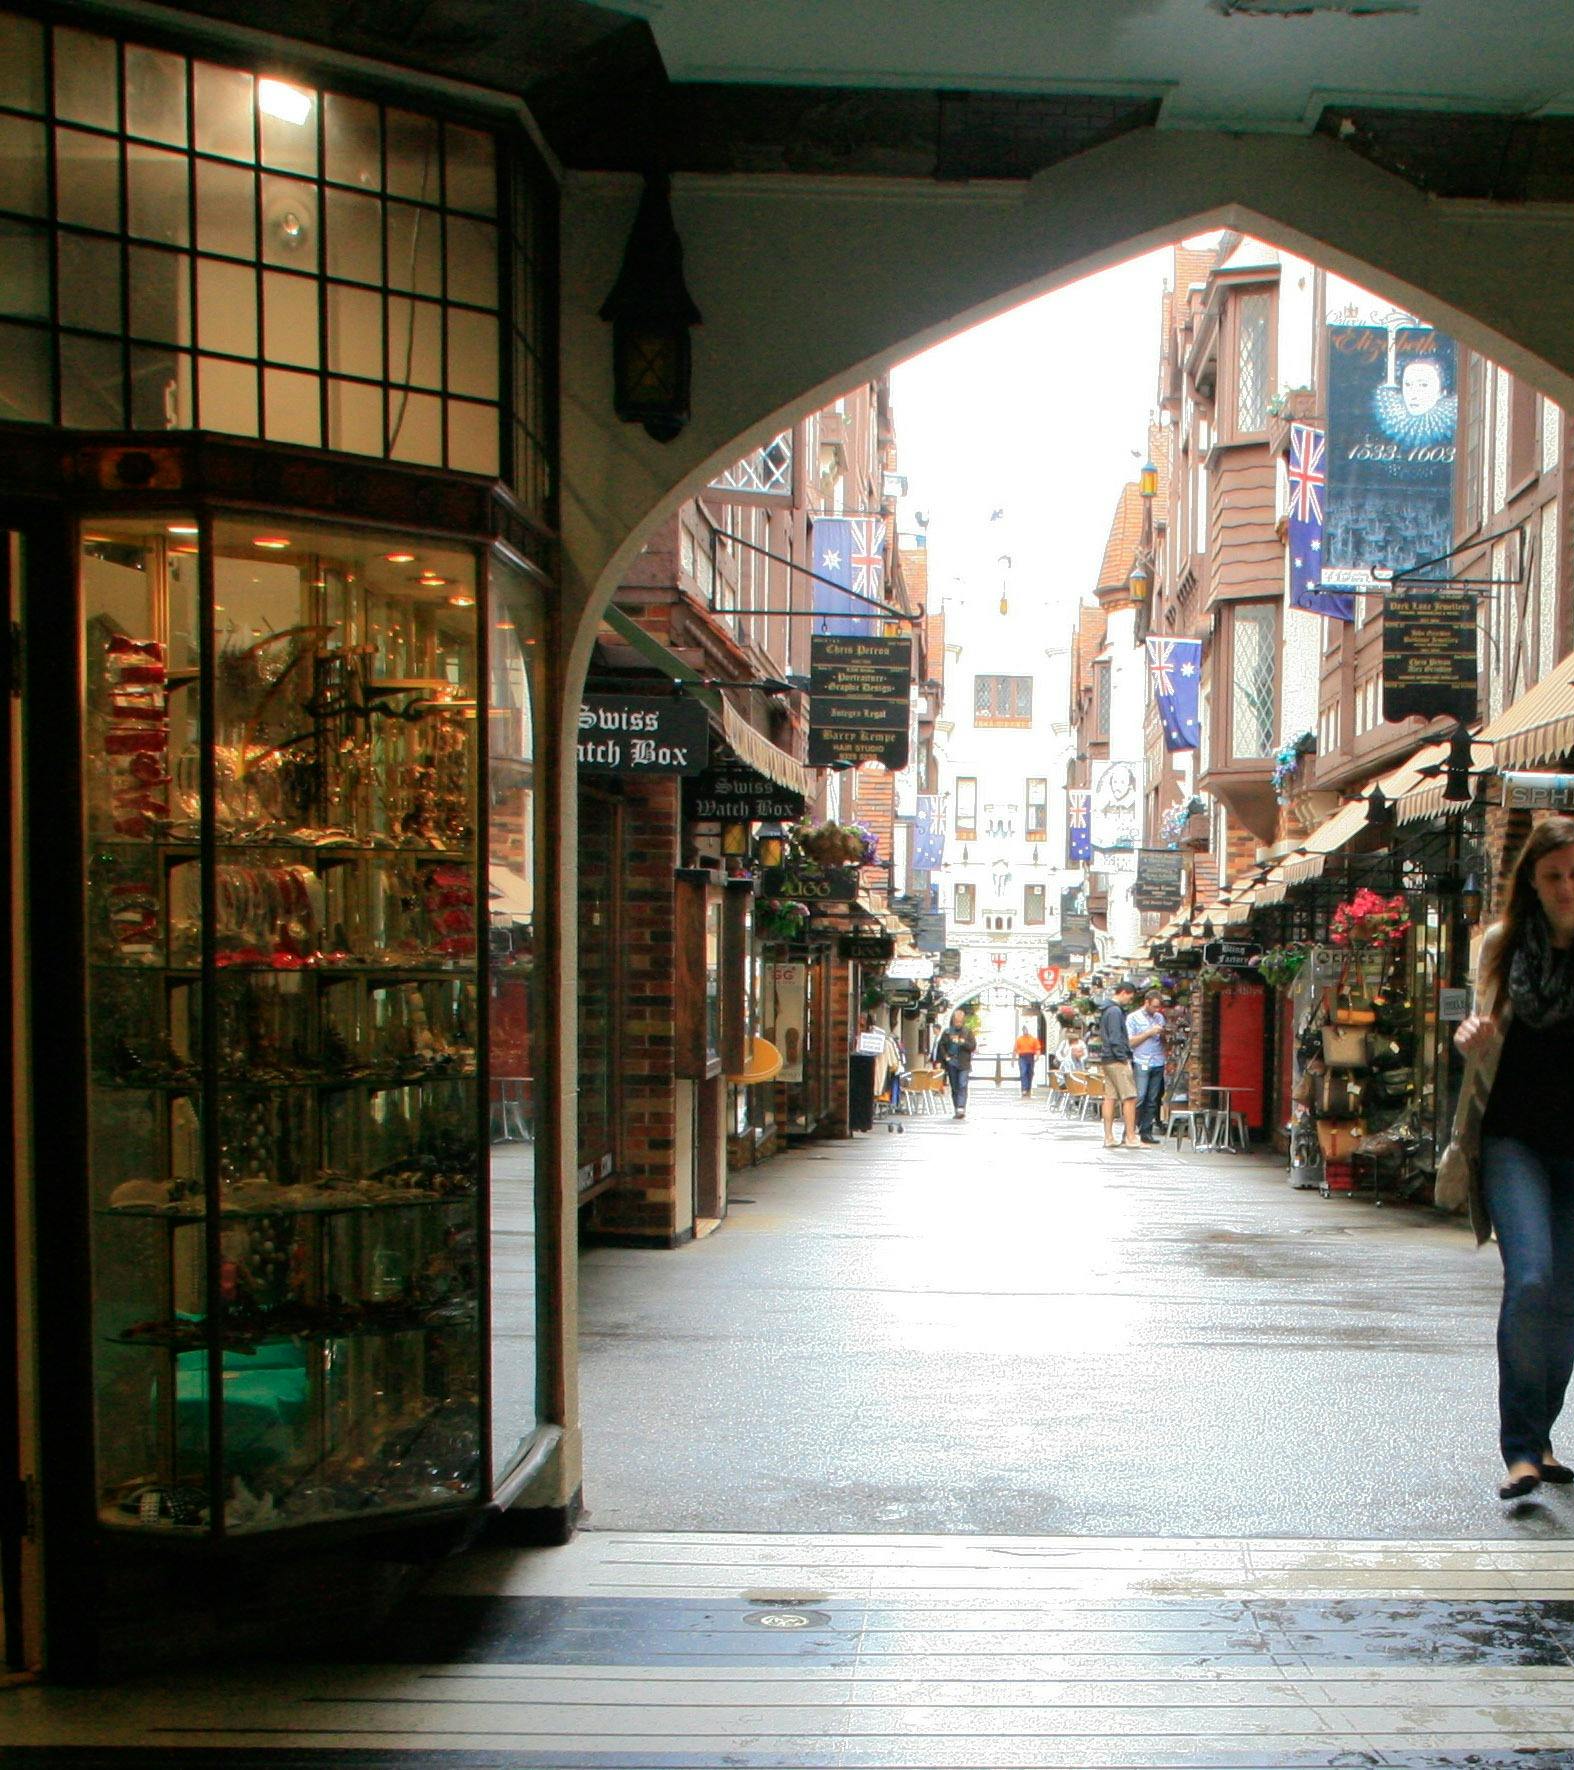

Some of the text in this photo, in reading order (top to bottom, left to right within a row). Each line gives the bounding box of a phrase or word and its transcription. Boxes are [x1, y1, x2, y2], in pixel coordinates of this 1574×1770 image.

[826, 644, 854, 656] Chris
[578, 704, 660, 731] Swiss
[577, 739, 688, 768] atch Box
[855, 744, 885, 753] STUDIO
[714, 777, 774, 795] Swiss
[696, 799, 795, 819] Watch Box
